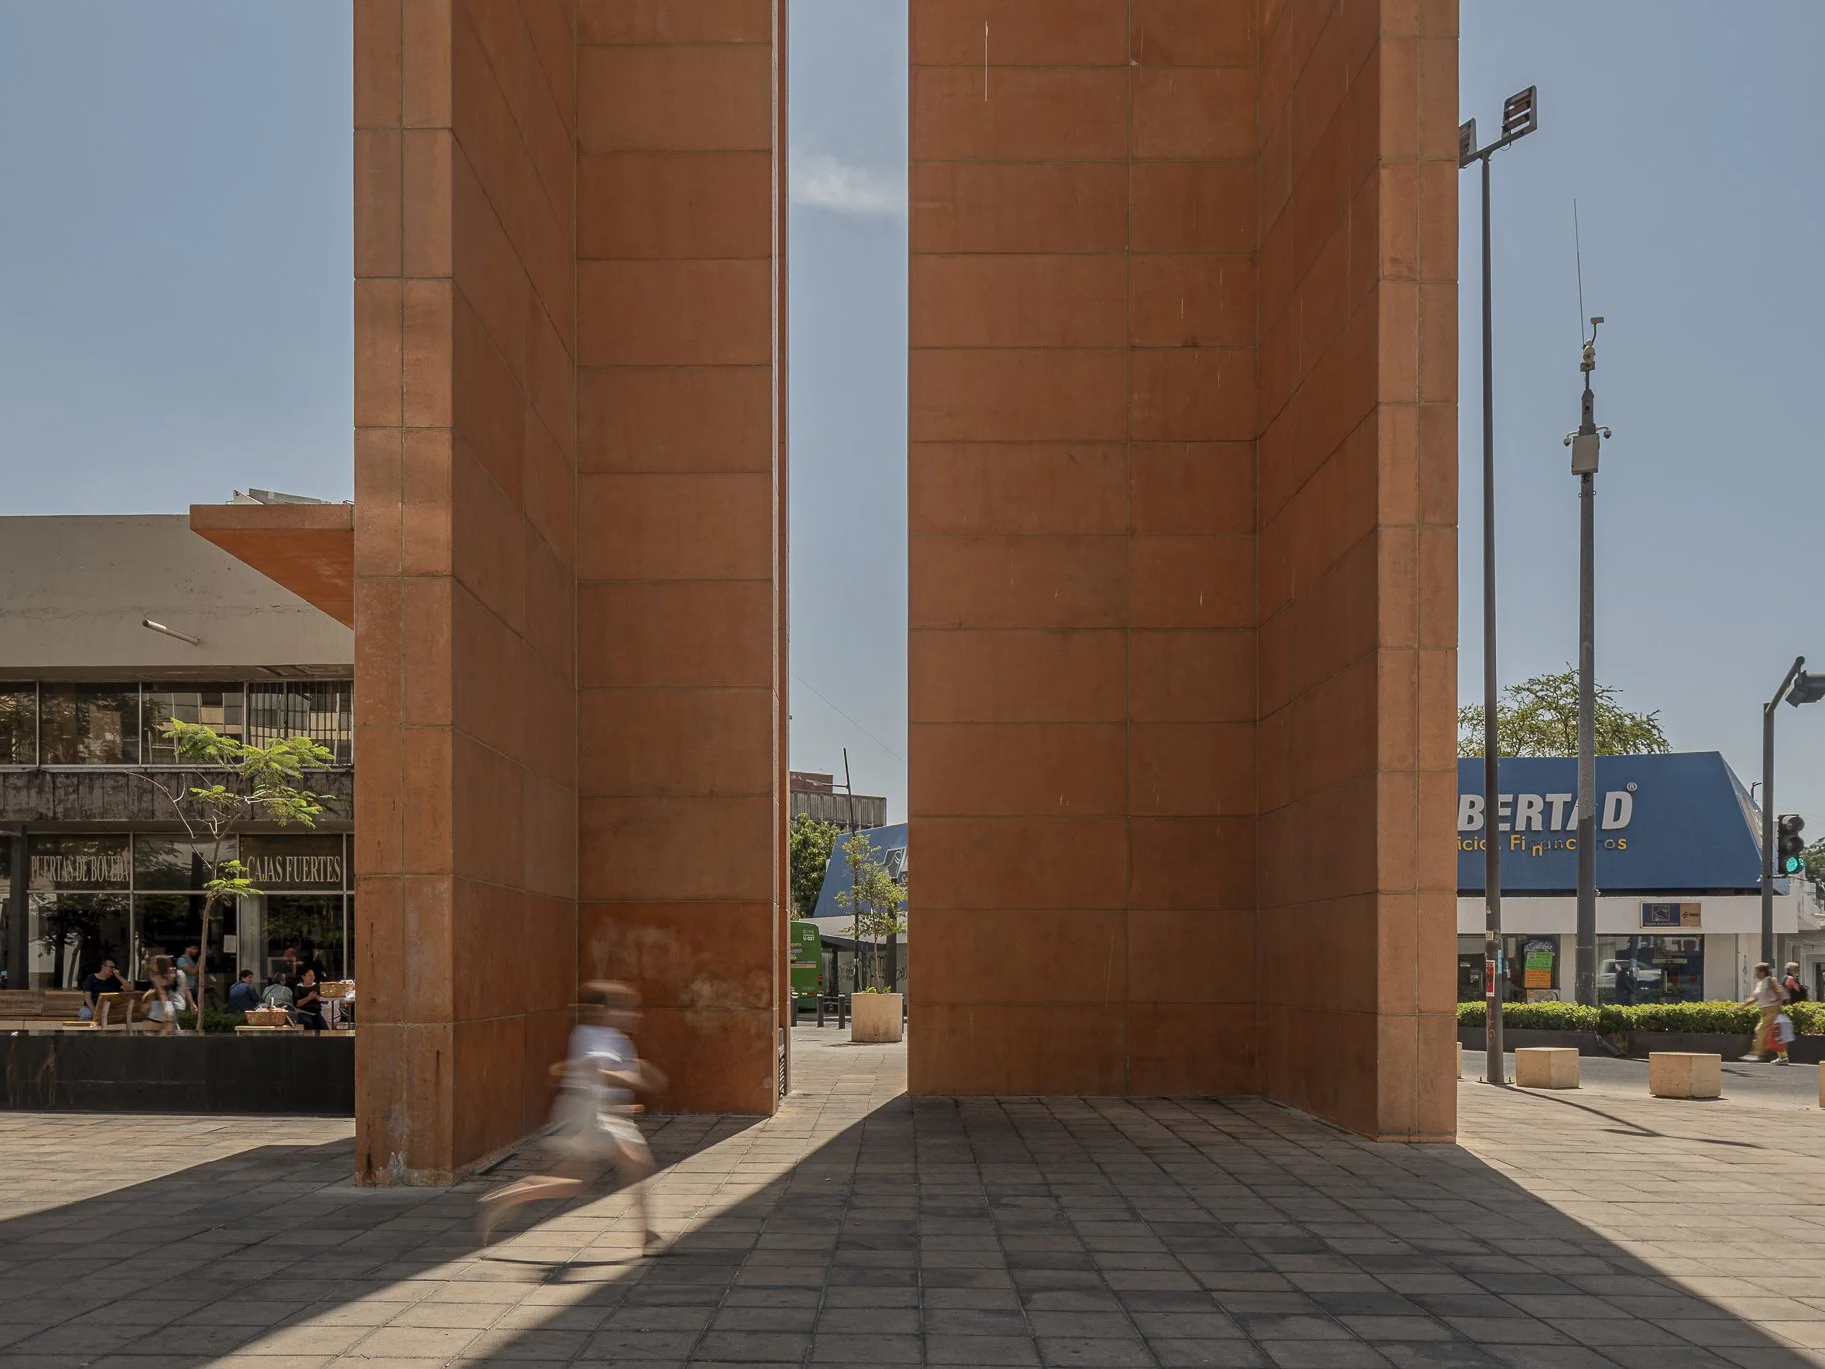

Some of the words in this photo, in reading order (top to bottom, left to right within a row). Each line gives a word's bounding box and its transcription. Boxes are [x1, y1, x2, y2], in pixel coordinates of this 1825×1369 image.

[31, 855, 74, 882] PUERTAS
[76, 855, 89, 881] DE
[247, 855, 283, 883] CAJAS
[285, 855, 341, 883] FUERTES
